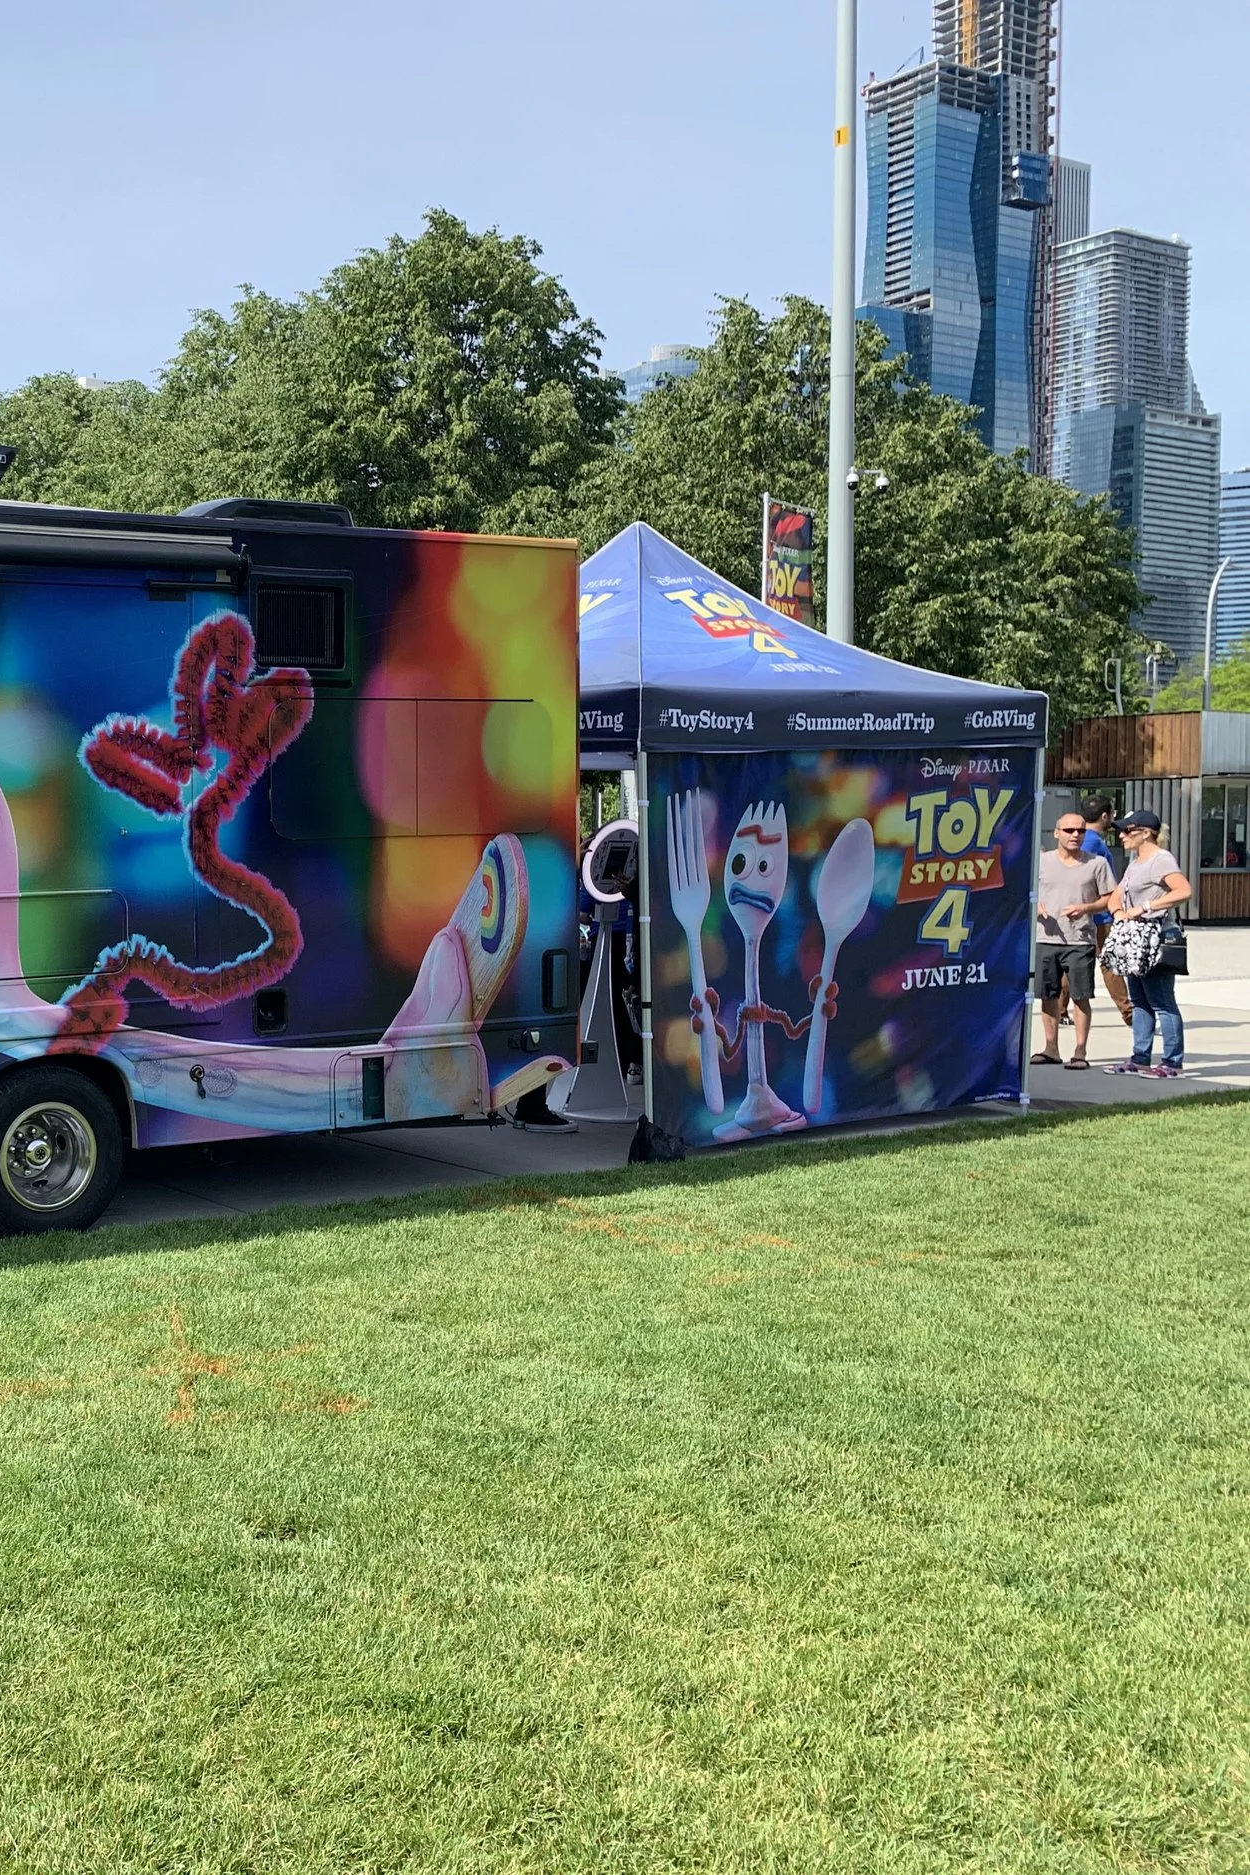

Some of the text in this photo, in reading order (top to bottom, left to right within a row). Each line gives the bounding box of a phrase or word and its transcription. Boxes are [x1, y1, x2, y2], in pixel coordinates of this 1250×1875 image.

[769, 559, 802, 599] TOY
[661, 588, 758, 620] TOY
[749, 631, 800, 660] 4
[659, 708, 1036, 733] #ToyStory4 #SummerRoadTrip #GoRVing
[920, 757, 1010, 781] Disney PIXAR
[907, 785, 1020, 860] TOY
[910, 859, 995, 884] STORY
[917, 885, 974, 958] 4
[901, 962, 988, 990] JUNE 21
